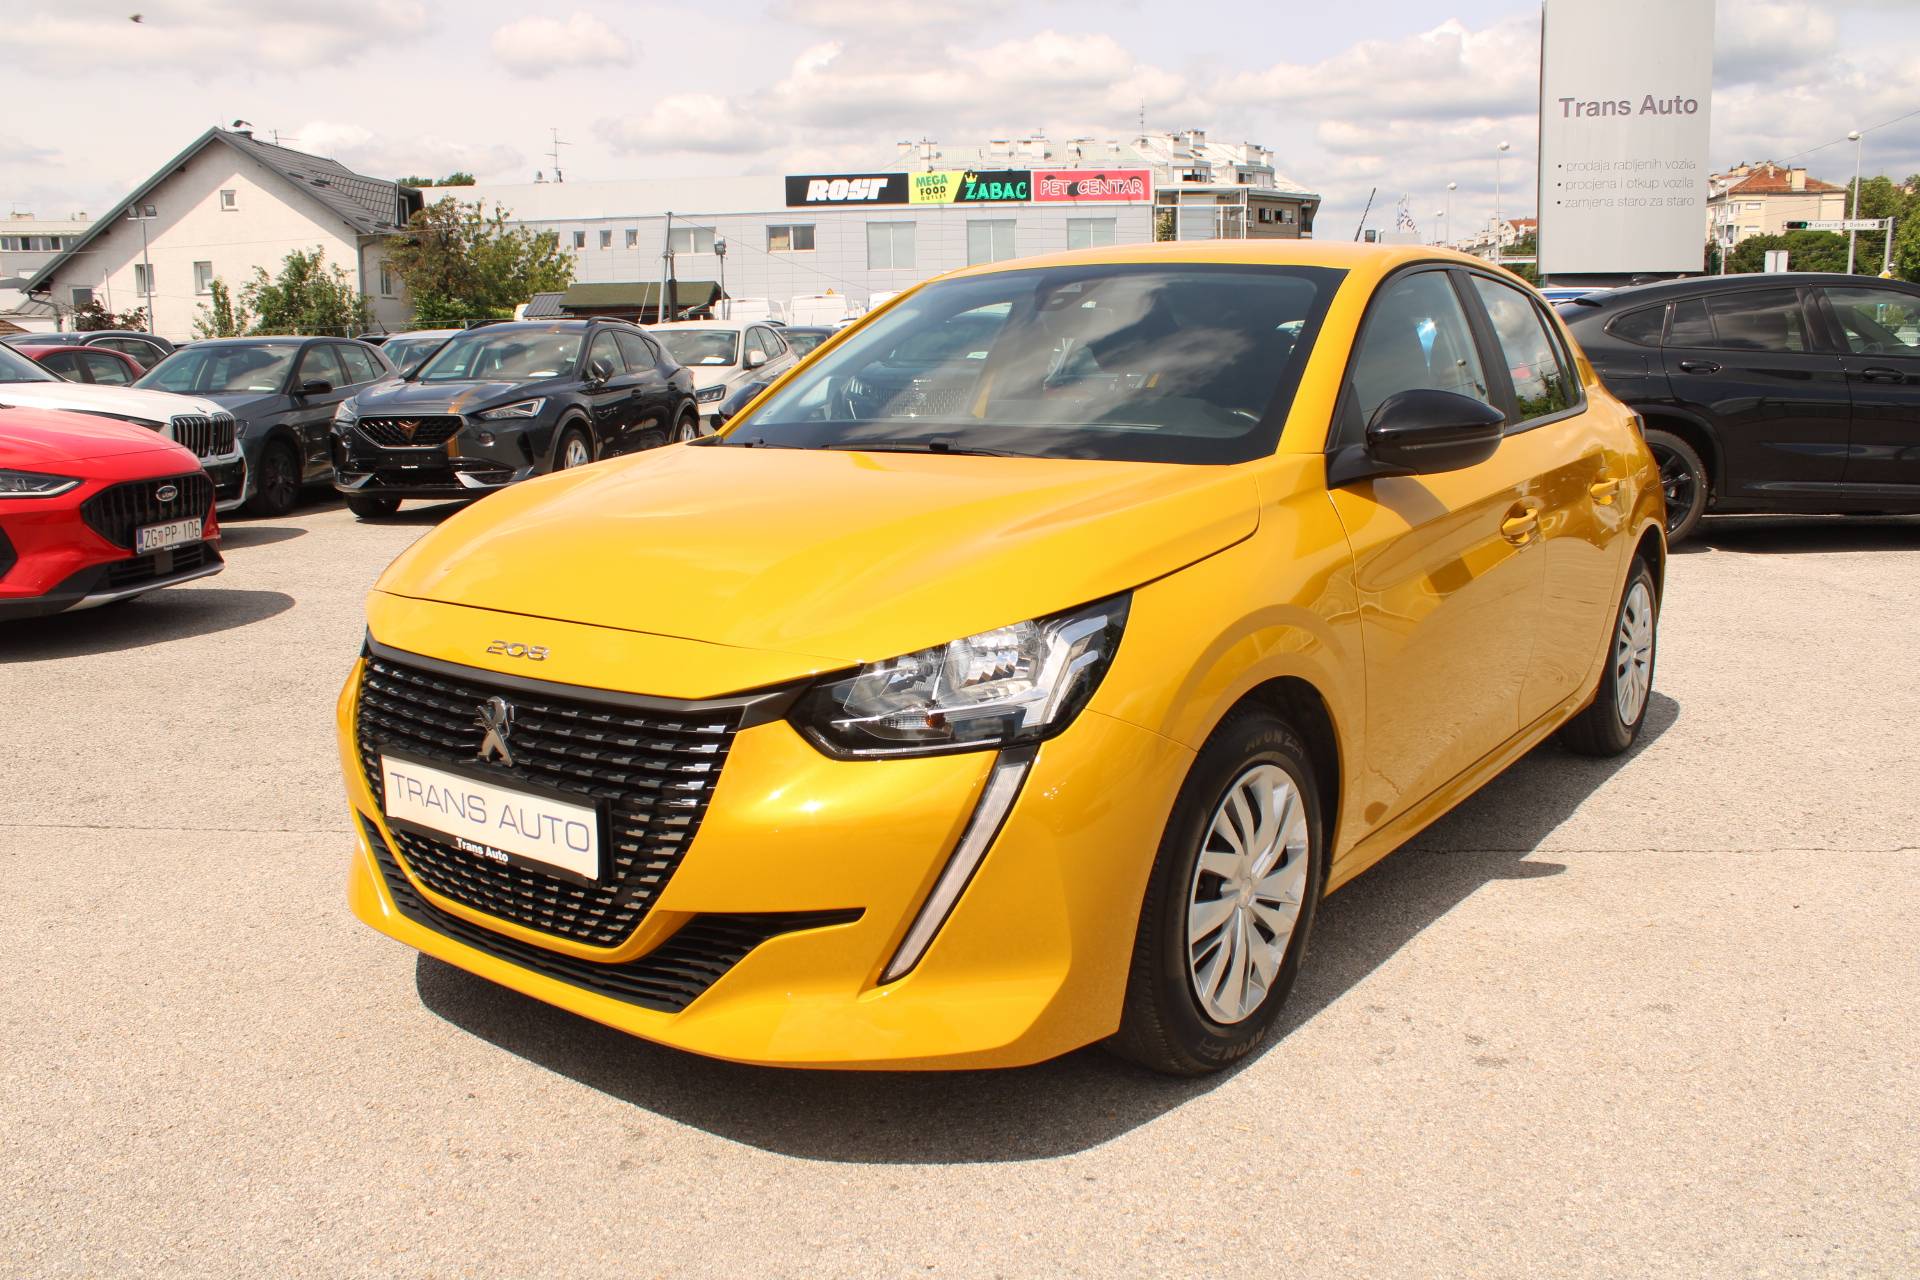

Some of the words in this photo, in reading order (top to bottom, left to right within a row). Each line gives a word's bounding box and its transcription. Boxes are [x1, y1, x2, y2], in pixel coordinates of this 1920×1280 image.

[1558, 97, 1632, 118] Trans
[1639, 94, 1698, 115] Auto
[1566, 159, 1610, 173] prodaja
[1612, 158, 1662, 173] rabljenih
[1665, 158, 1696, 170] vozila
[916, 174, 948, 188] MEGA
[1040, 179, 1073, 196] PET
[1076, 178, 1144, 196] CENTAR
[1565, 178, 1617, 193] procjena
[1626, 177, 1660, 191] otkup
[1663, 177, 1694, 189] vozila
[920, 185, 946, 196] FOOD
[1564, 197, 1614, 211] zamjena
[1617, 196, 1646, 207] staro
[1648, 196, 1663, 207] za
[1666, 196, 1695, 207] staro
[486, 639, 550, 661] 208
[390, 771, 487, 825] TRANS
[498, 804, 590, 853] AUTO
[455, 836, 484, 855] Trans
[485, 846, 509, 863] Auto
